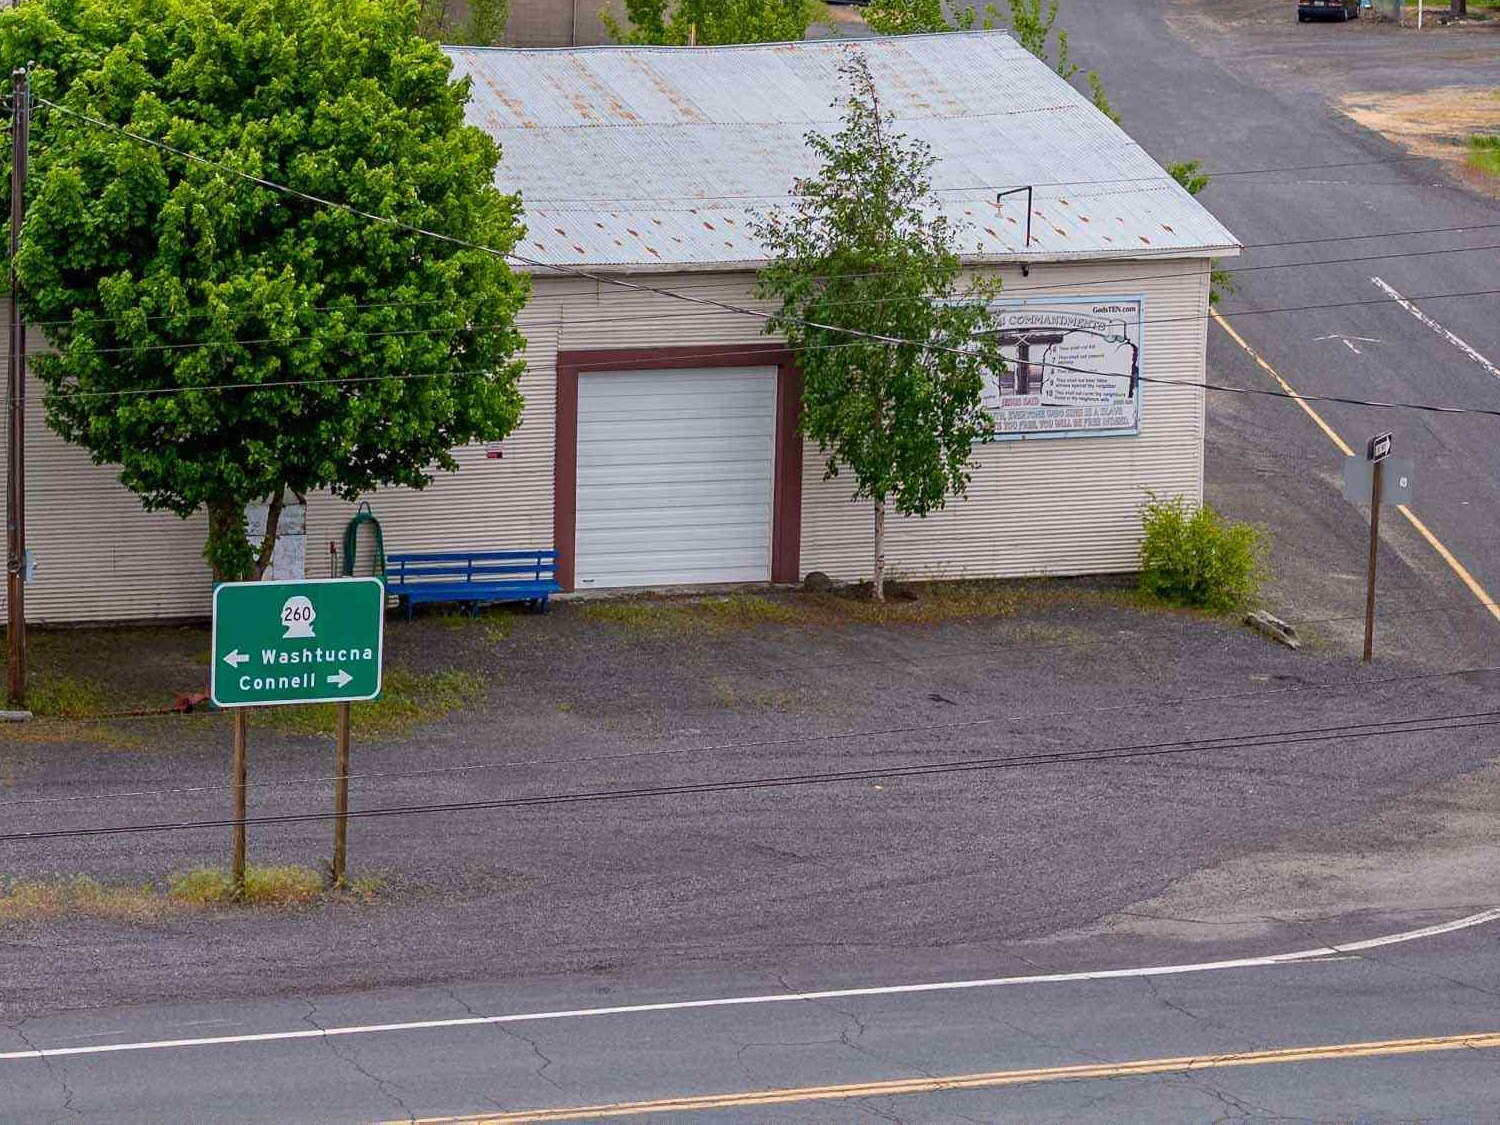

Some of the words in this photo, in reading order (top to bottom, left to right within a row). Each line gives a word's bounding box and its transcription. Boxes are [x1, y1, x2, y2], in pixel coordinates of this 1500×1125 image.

[284, 607, 311, 622] 260
[261, 648, 372, 665] Washtucna
[239, 673, 316, 690] Connell
